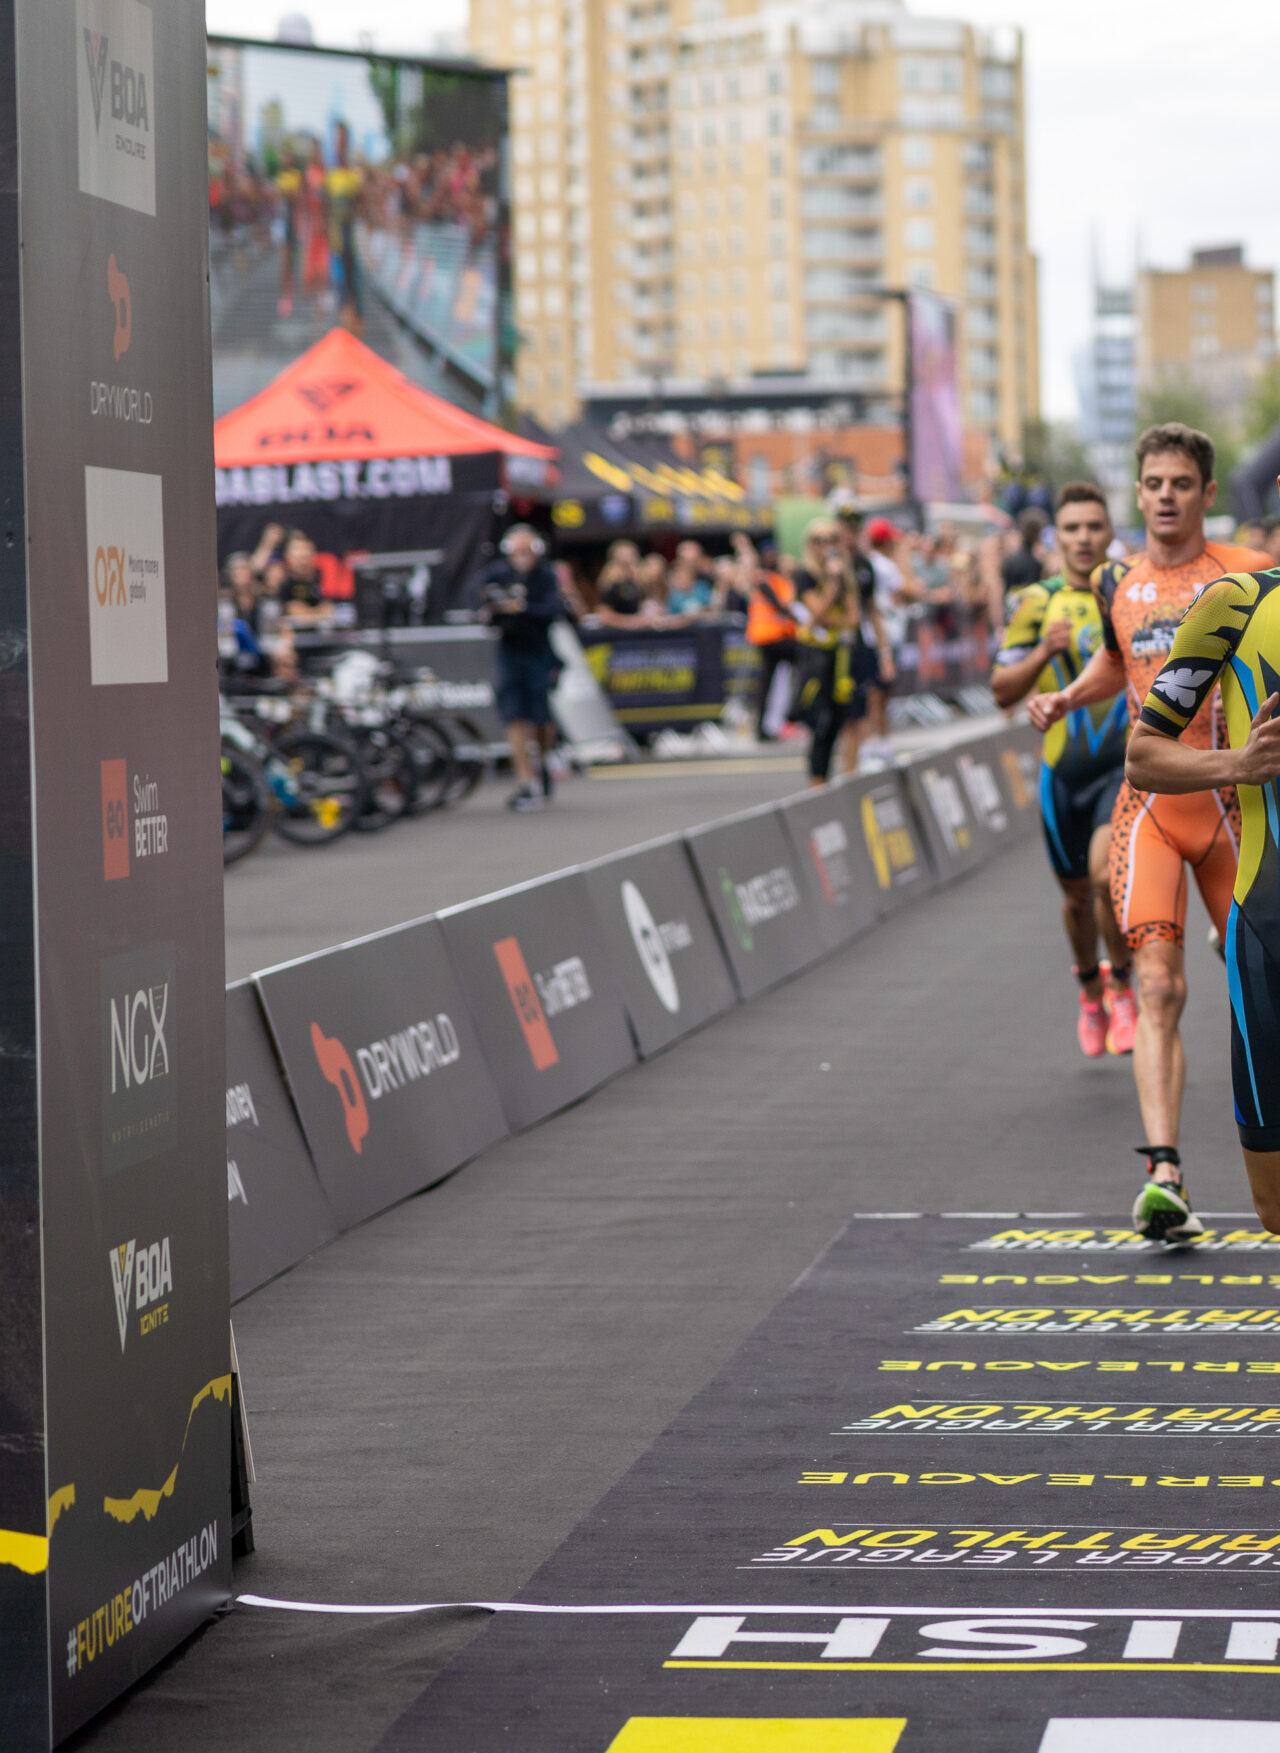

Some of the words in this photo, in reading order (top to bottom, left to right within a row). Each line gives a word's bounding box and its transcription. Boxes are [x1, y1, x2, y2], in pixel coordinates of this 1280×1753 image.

[111, 60, 149, 132] BOA
[90, 381, 153, 424] DRYWORLD
[94, 546, 127, 606] OFX
[1126, 582, 1157, 603] 46
[133, 774, 159, 814] Swim
[106, 800, 125, 840] eo
[134, 815, 168, 857] BETTER
[356, 1012, 461, 1100] DRYWORLD
[135, 1236, 173, 1310] BOA
[139, 1303, 169, 1336] IGNITE
[913, 1320, 1151, 1331] LEAGUE
[841, 1418, 1112, 1431] LEAGUE
[750, 1547, 1060, 1564] LEAGUE
[66, 1519, 218, 1679] #FUTUREOFTRIATHLON
